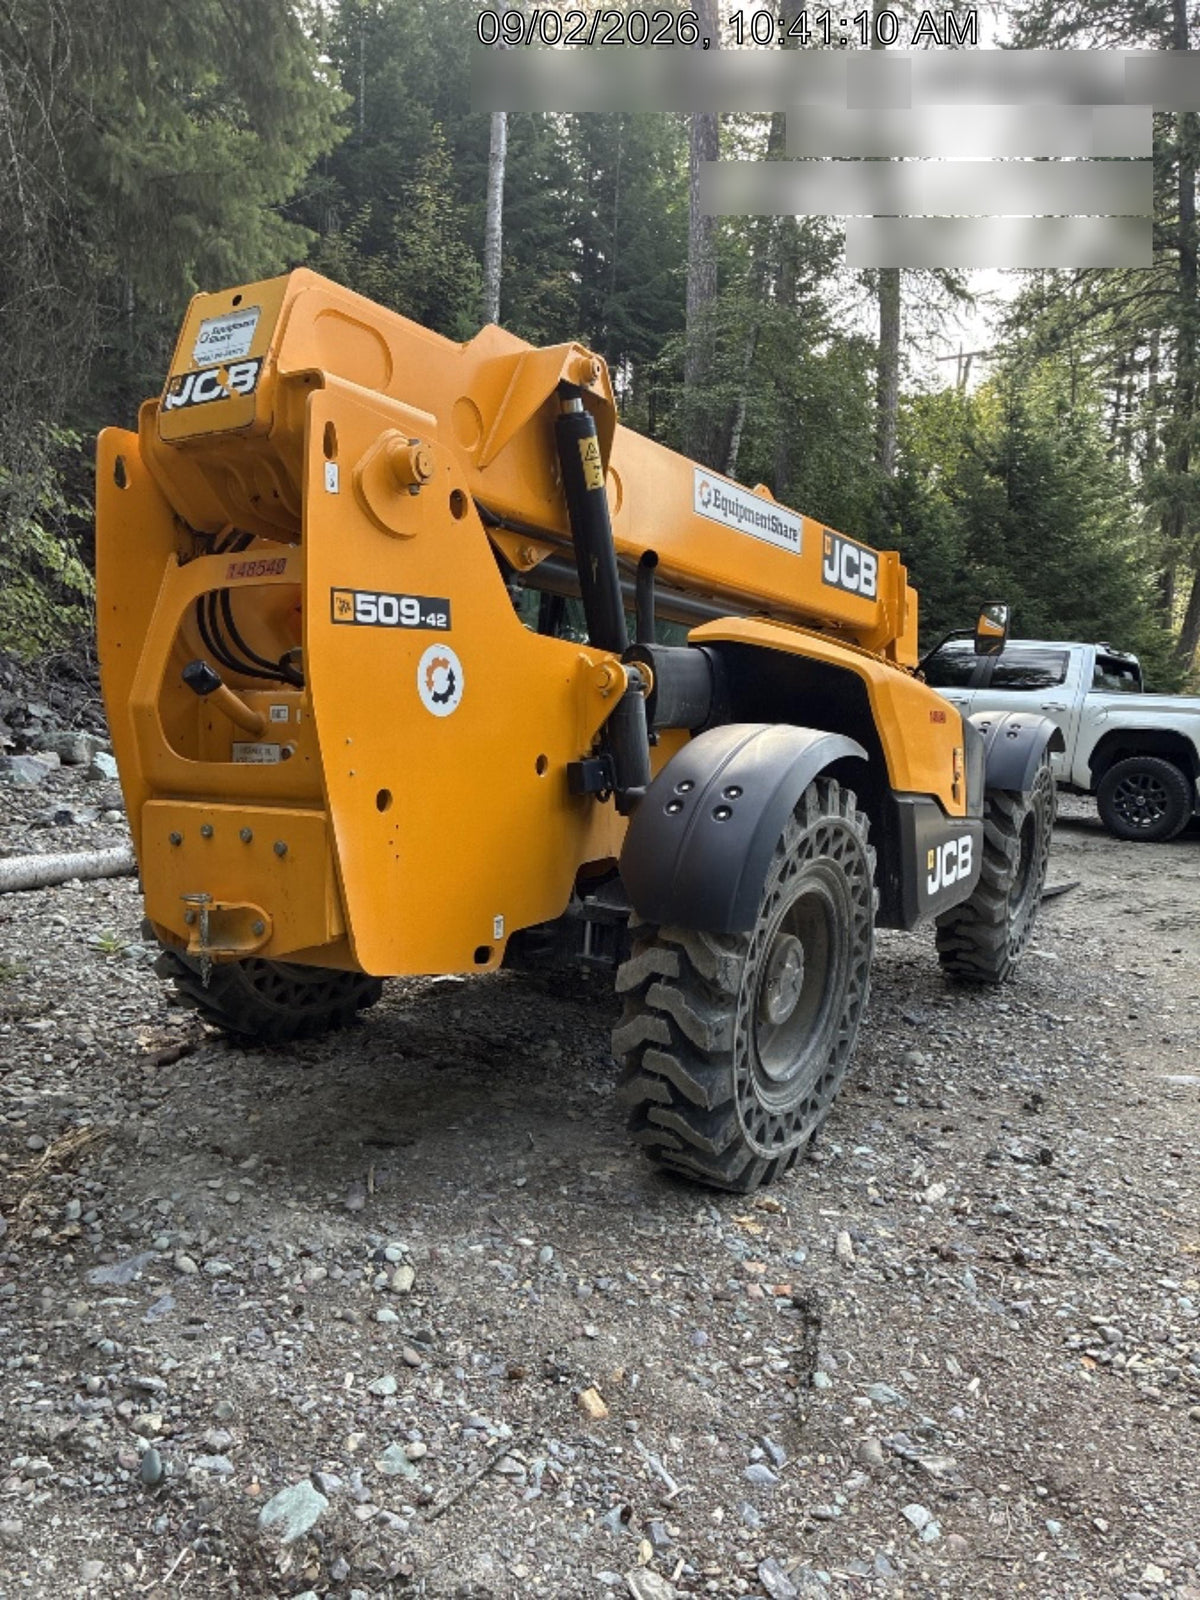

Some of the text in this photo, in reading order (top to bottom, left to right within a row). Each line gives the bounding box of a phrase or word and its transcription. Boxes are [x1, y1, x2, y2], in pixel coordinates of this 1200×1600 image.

[165, 361, 259, 410] JCB
[712, 487, 799, 543] EquipmentShare
[824, 540, 877, 597] JCB
[927, 834, 973, 896] JCB
